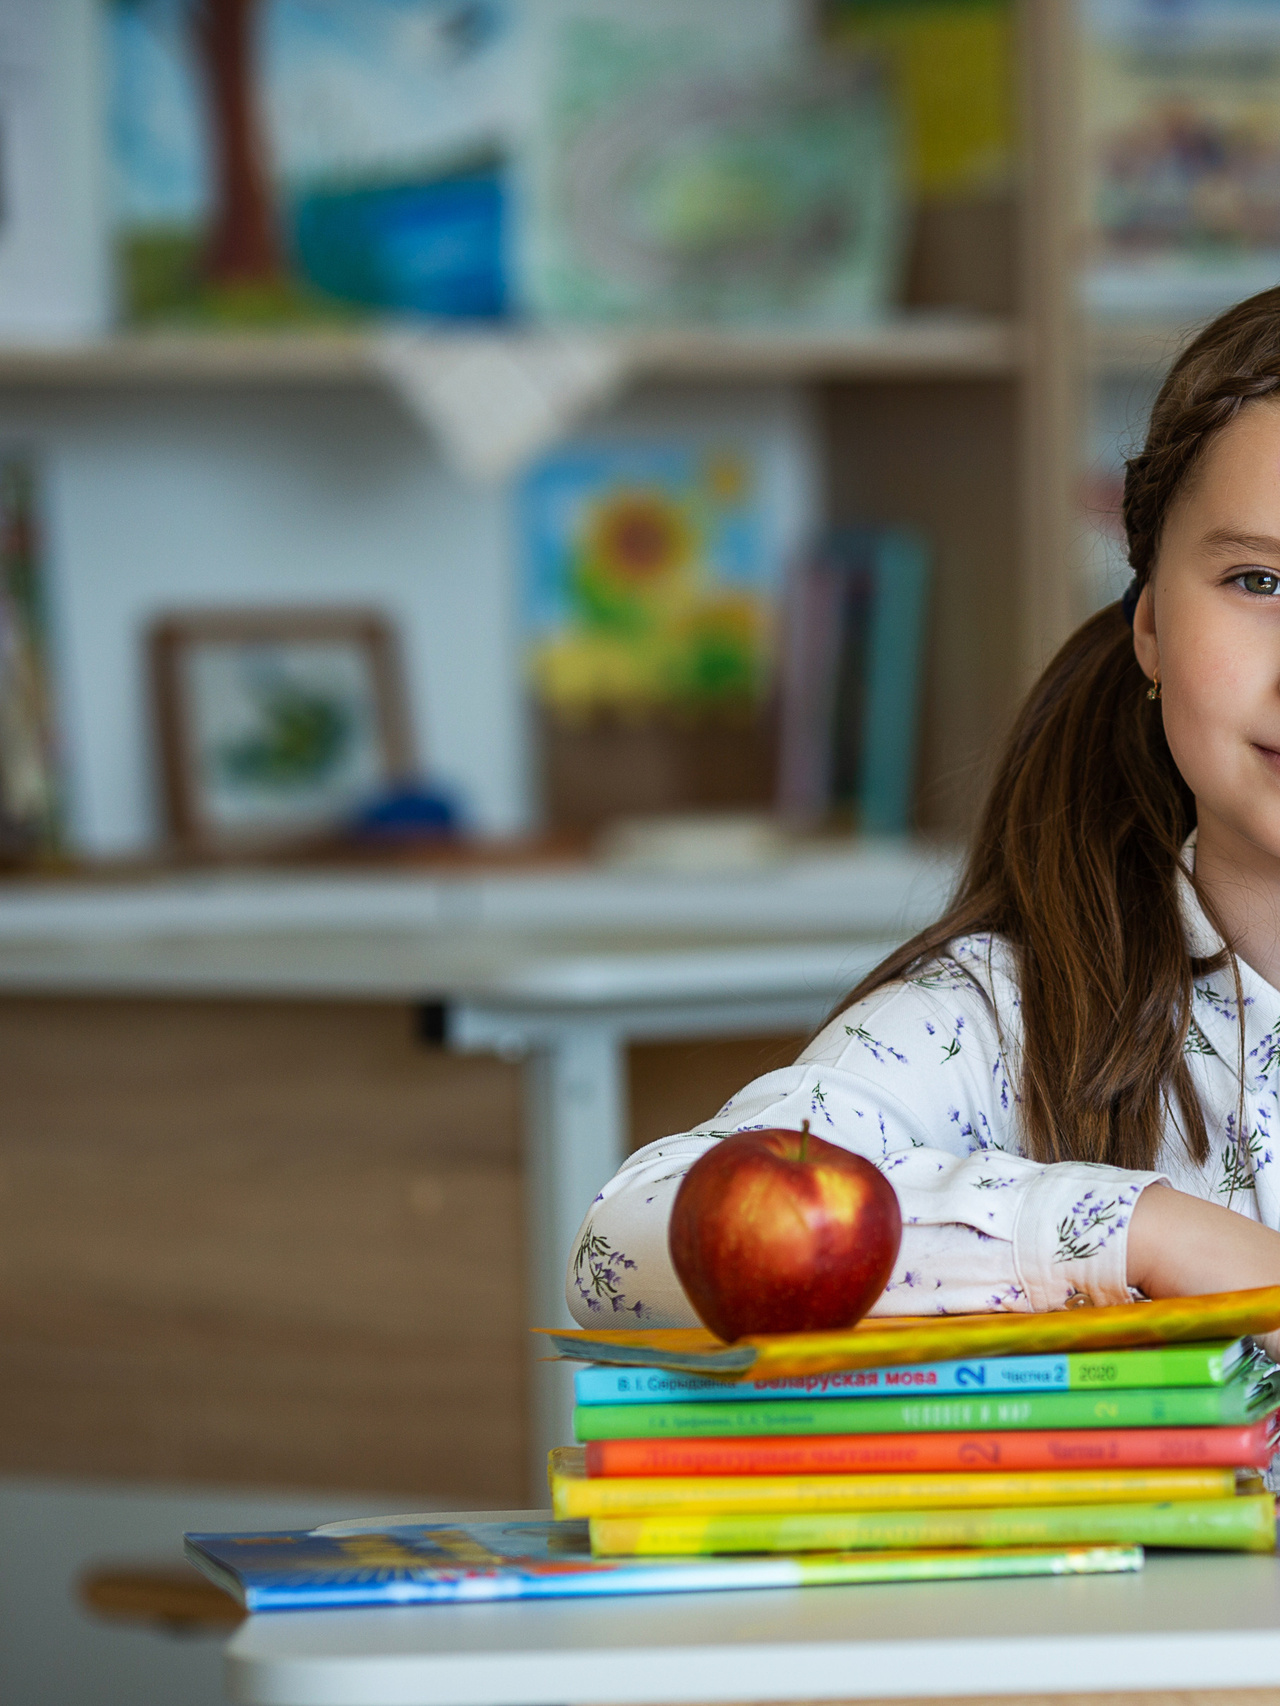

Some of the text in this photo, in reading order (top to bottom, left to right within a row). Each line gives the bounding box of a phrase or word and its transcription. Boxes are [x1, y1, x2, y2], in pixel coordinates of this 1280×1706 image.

[884, 1371, 937, 1386] мова
[955, 1363, 986, 1387] 2
[1053, 1363, 1066, 1382] 2
[1079, 1364, 1117, 1382] 2020
[957, 1440, 1000, 1465] 2
